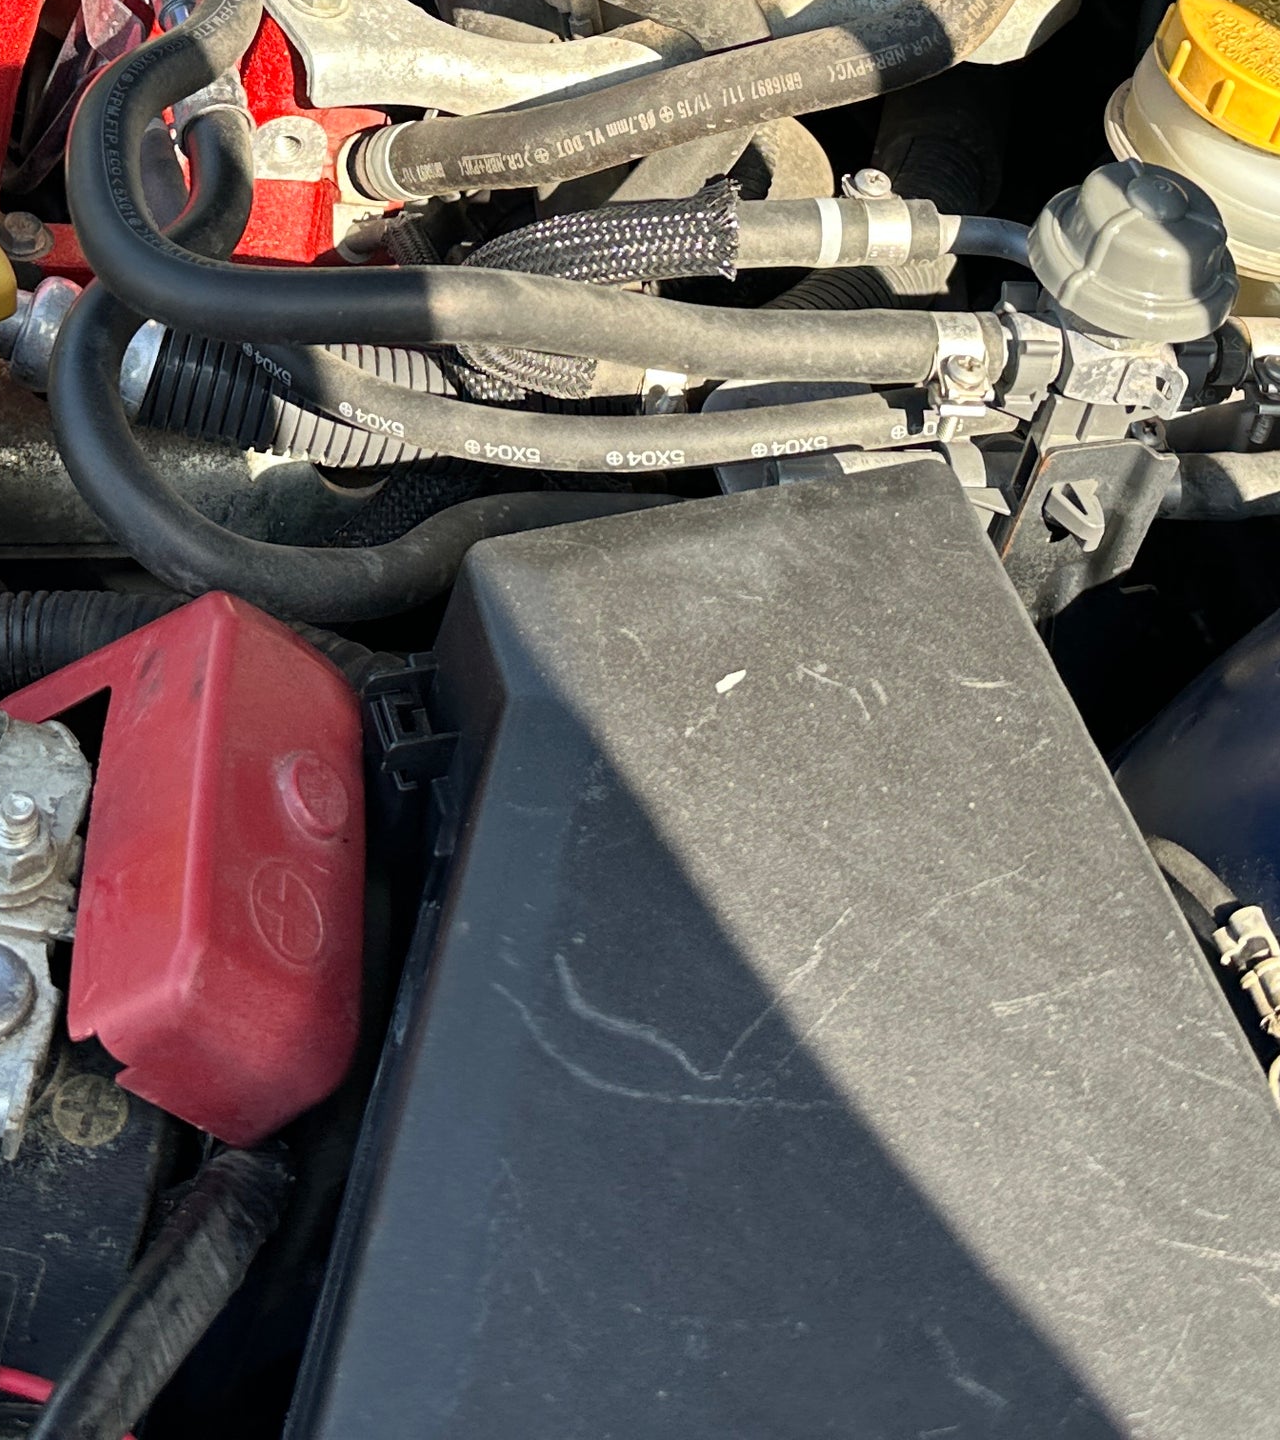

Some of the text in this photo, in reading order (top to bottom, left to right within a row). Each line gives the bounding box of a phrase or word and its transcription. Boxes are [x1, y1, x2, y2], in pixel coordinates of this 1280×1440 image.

[355, 407, 405, 438] 5X04
[483, 442, 541, 464] 5X04
[626, 450, 685, 467] 5X04
[771, 436, 828, 457] 5X04
